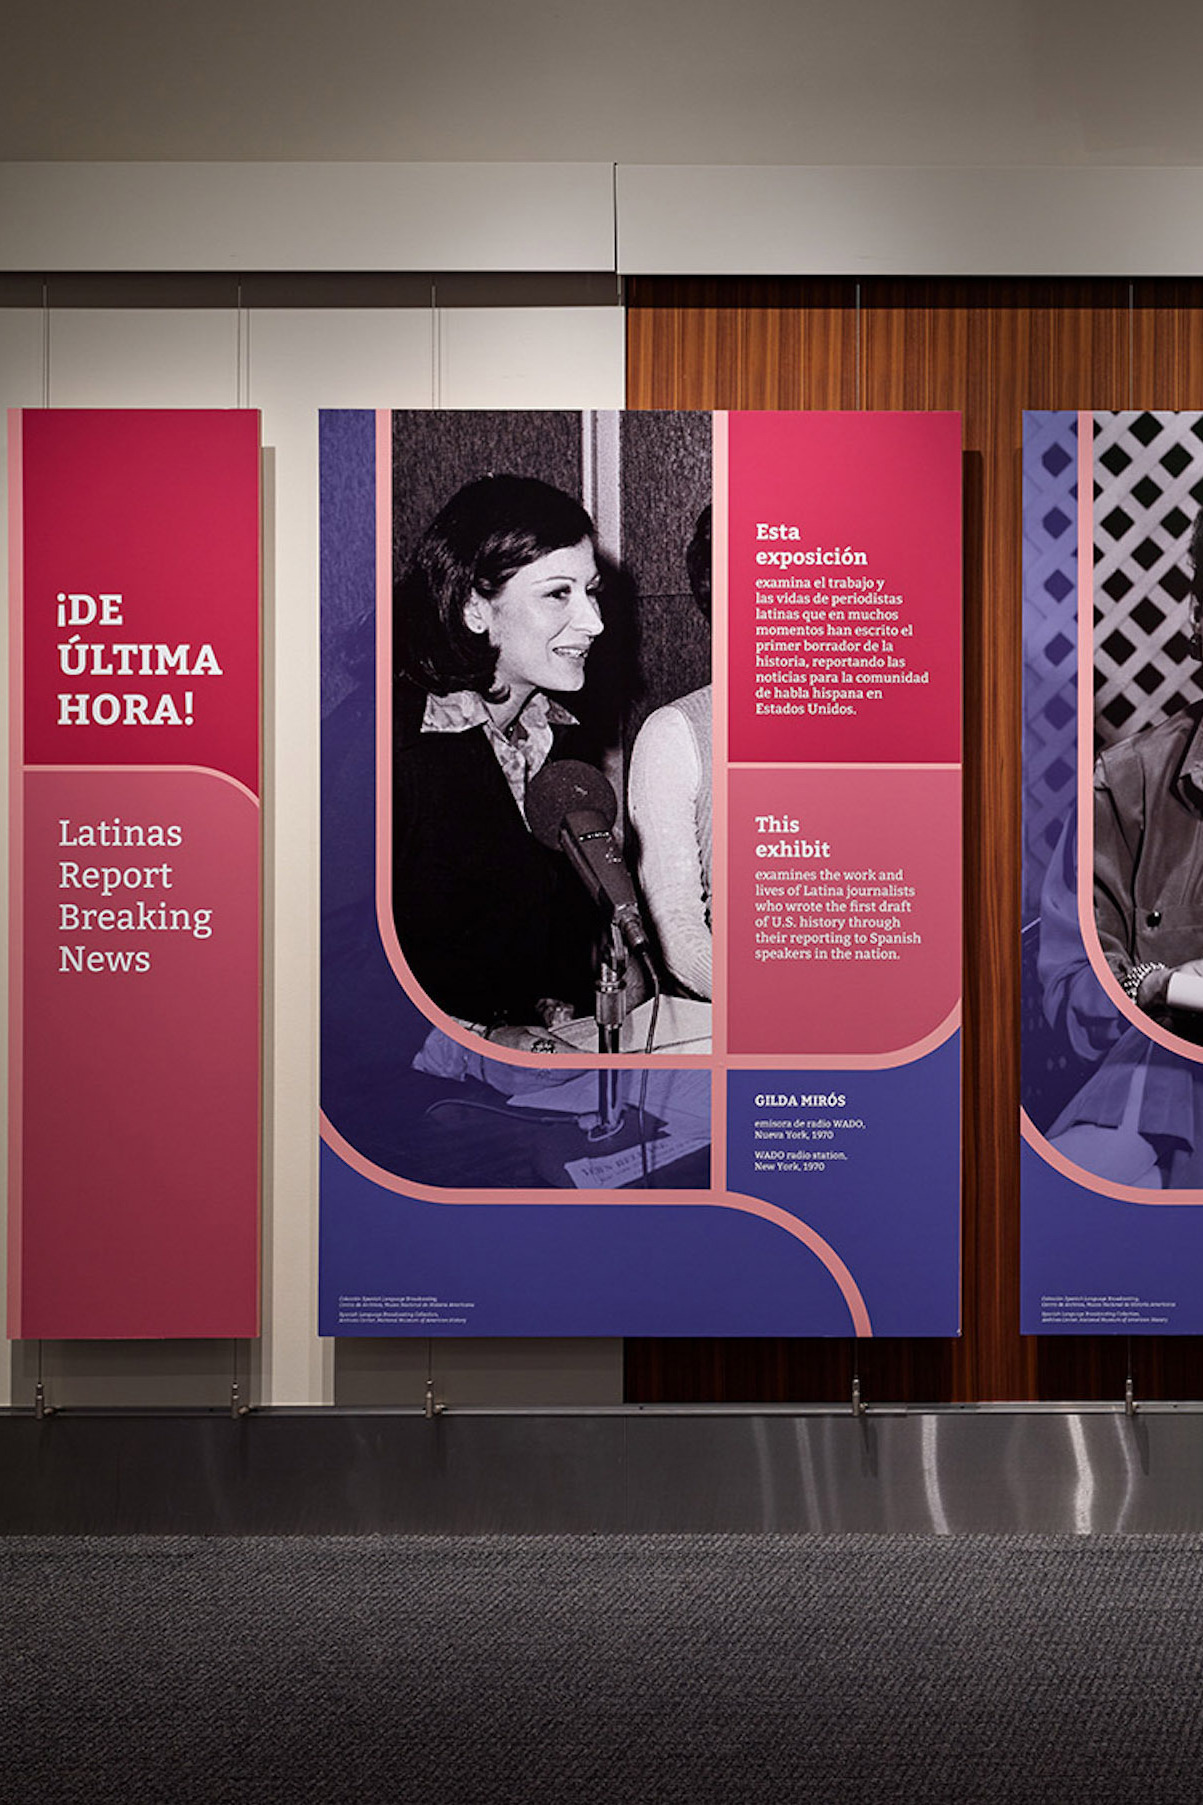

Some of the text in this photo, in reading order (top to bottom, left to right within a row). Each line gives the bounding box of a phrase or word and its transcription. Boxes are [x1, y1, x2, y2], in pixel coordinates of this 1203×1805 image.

[756, 523, 801, 541] Esta
[756, 546, 868, 570] exposición
[755, 577, 885, 592] examina el trabajo y
[756, 592, 903, 607] las vidas de periodistas
[57, 593, 123, 627] ¡DE
[756, 608, 899, 623] latinas que en muchos
[756, 624, 913, 636] momentos han escrito el
[57, 634, 223, 675] ÚLTIMA
[756, 655, 906, 670] historia, reportando las
[756, 671, 929, 686] noticias para la comunidad
[755, 686, 883, 702] de habla hispana en
[57, 691, 194, 725] HORA!
[756, 702, 857, 715] Estados Unidos.
[755, 815, 800, 833] This
[59, 818, 182, 846] Latinas
[755, 840, 830, 858] exhibit
[59, 862, 173, 896] Report
[755, 868, 903, 881] examines the work and
[755, 884, 916, 899] lives of Latina journalists
[59, 901, 213, 939] Breaking
[755, 916, 901, 931] of U.S. history through
[755, 931, 921, 947] their reporting to Spanish
[59, 946, 150, 972] News
[755, 947, 900, 962] speakers in the nation.
[755, 1092, 846, 1107] GILDA MIRÓS
[754, 1130, 834, 1140] Nueva York, 1970
